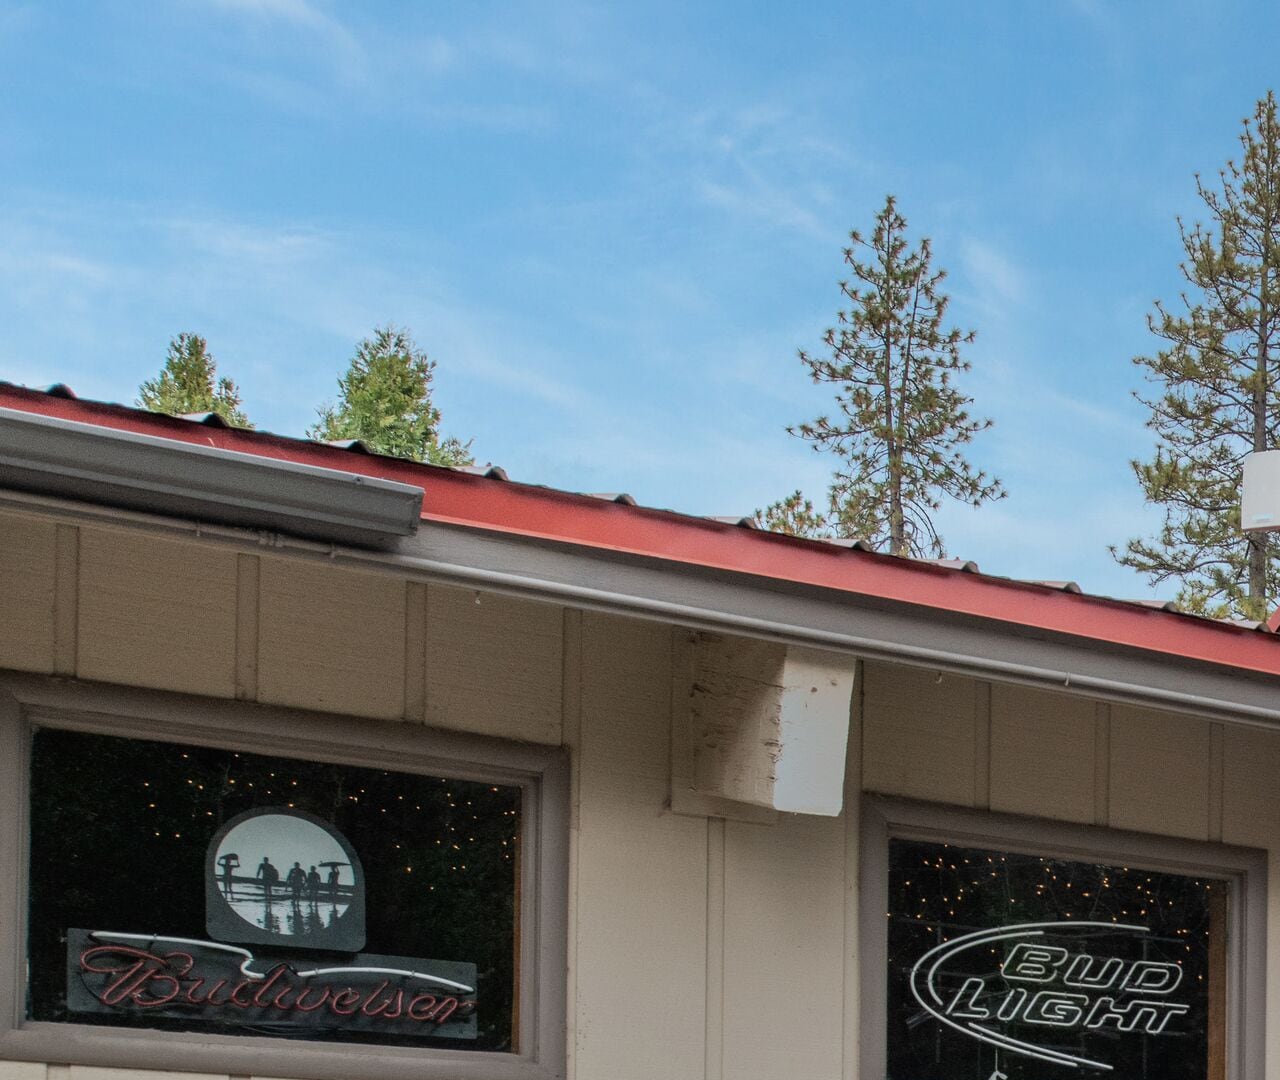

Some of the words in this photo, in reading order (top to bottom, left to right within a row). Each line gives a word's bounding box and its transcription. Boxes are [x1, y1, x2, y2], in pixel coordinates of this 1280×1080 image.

[80, 946, 476, 1024] Budweiser
[1001, 943, 1183, 994] BUD
[945, 978, 1190, 1033] LIGHT
